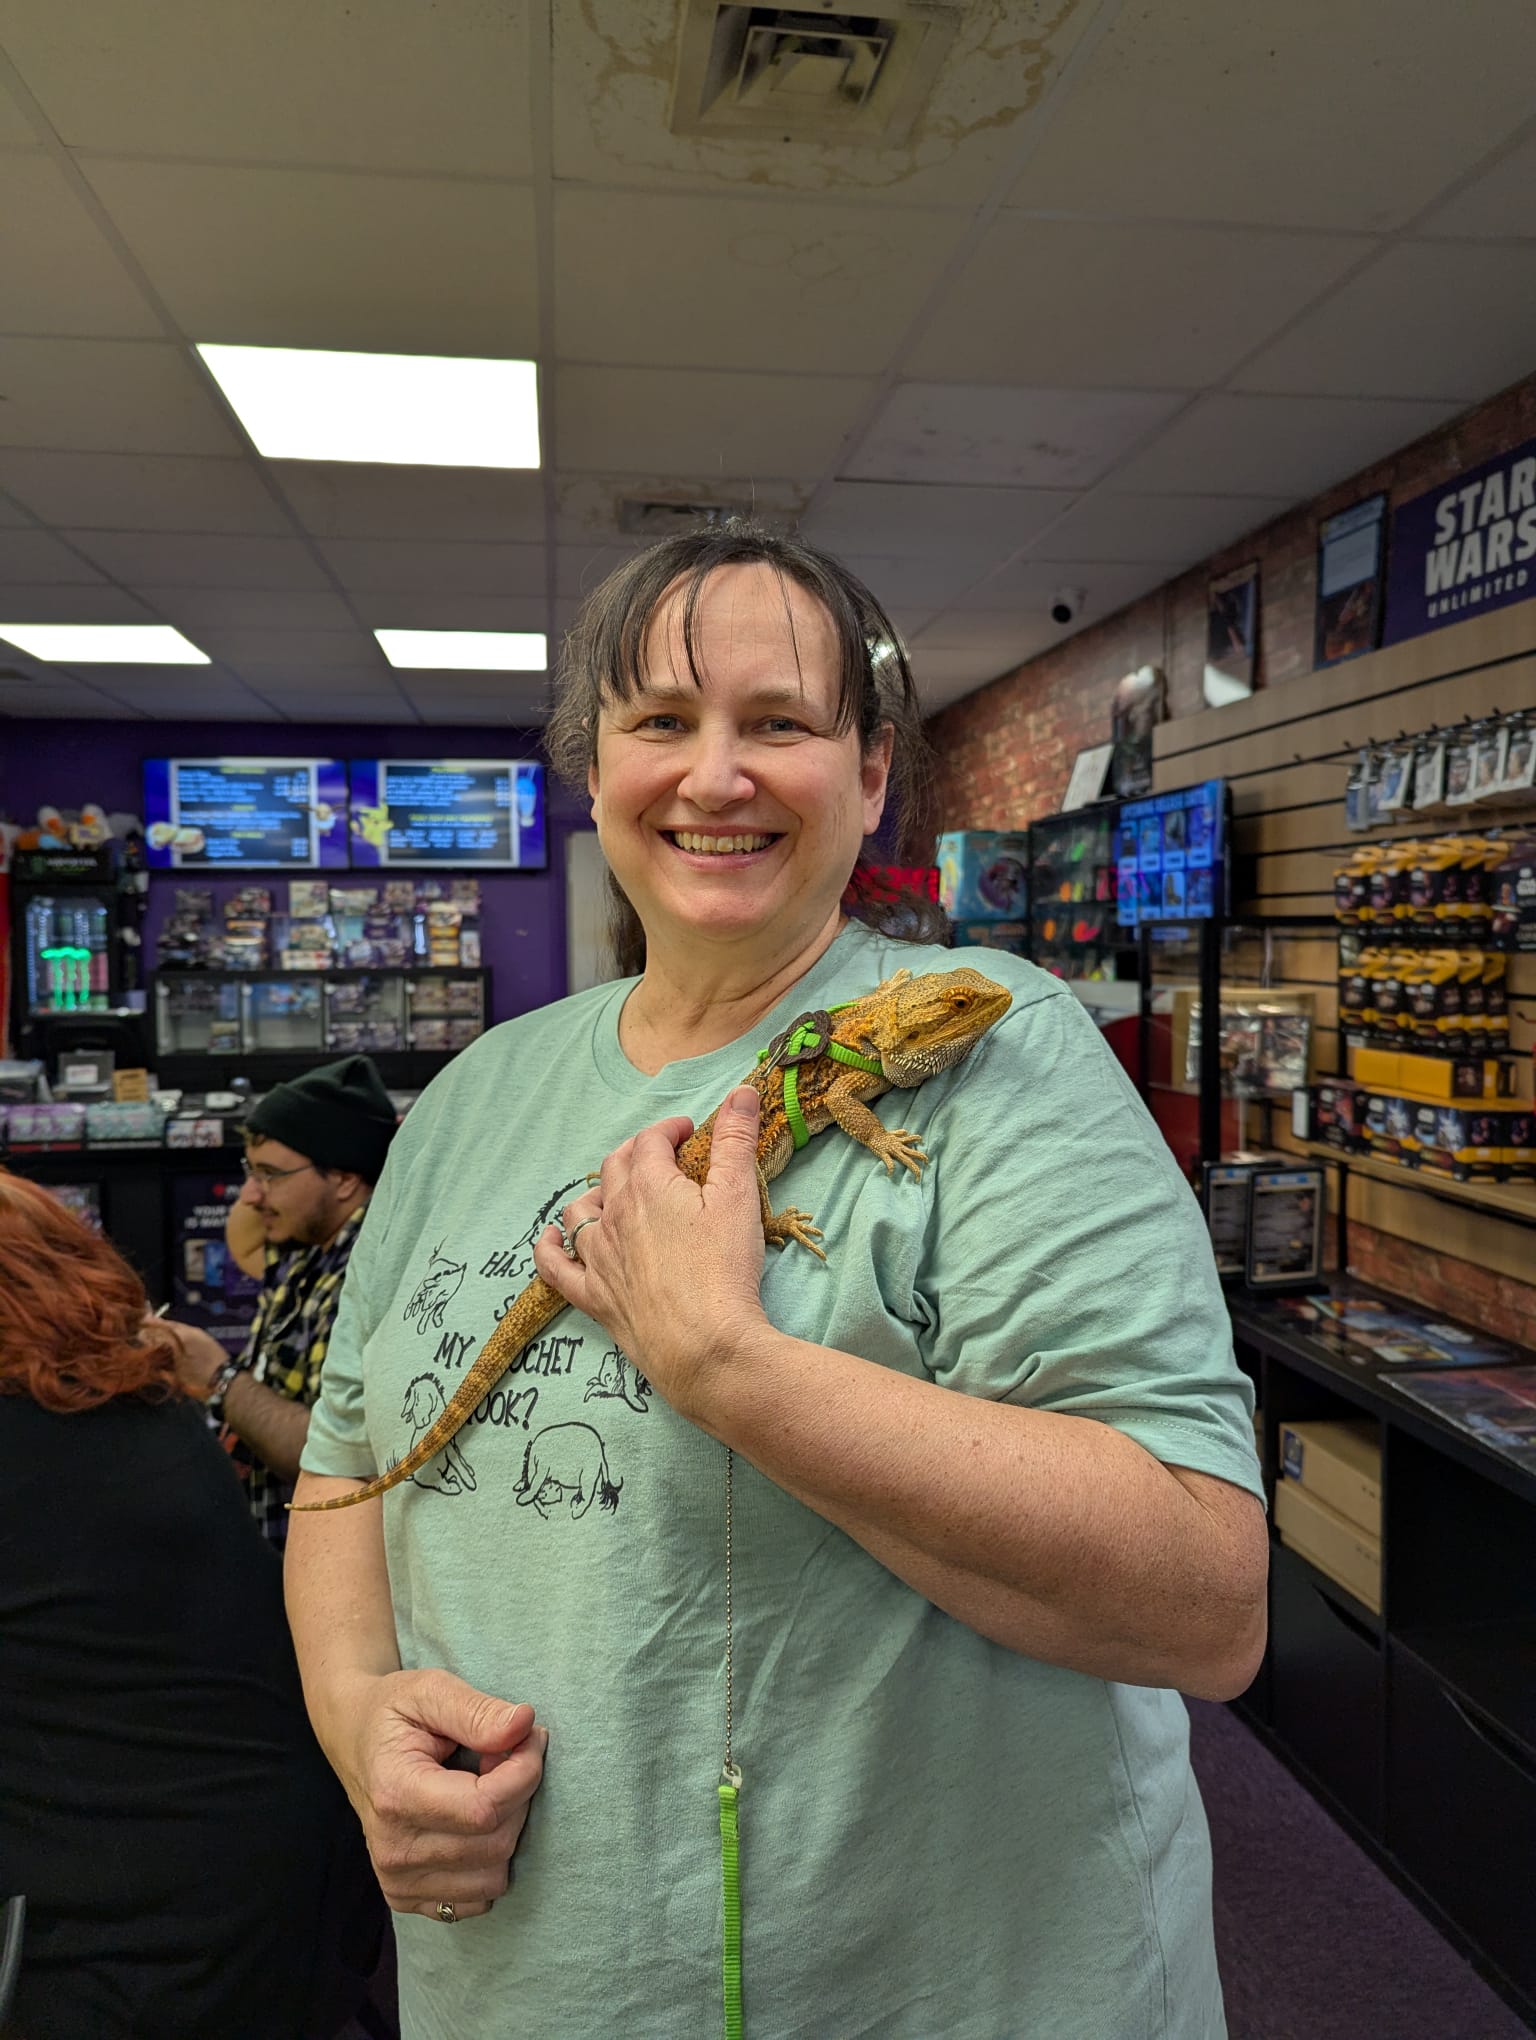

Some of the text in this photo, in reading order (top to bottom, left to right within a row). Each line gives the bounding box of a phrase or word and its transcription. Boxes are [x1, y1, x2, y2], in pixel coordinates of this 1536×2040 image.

[1434, 456, 1536, 546] STAR
[1425, 504, 1536, 597] WARS
[1427, 569, 1528, 618] UNLIMITED
[479, 1251, 532, 1278] HAS
[433, 1332, 476, 1369] MY
